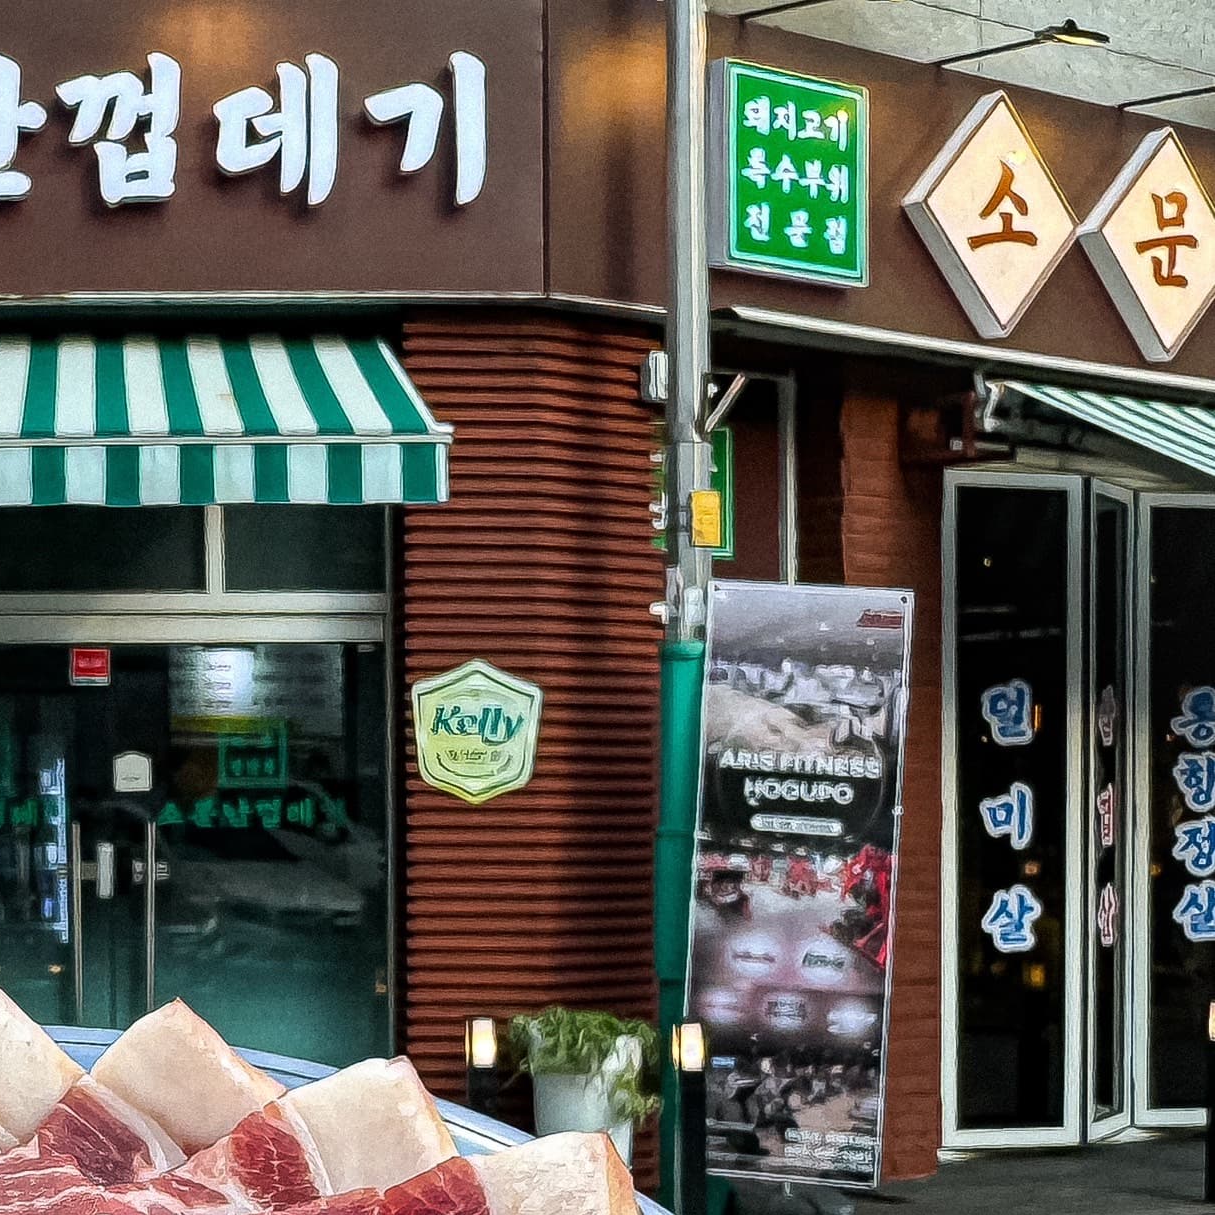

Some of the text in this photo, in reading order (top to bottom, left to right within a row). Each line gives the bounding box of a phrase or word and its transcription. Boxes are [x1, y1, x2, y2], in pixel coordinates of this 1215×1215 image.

[742, 95, 850, 152] 돼지고기
[740, 147, 850, 204] 특수부위
[430, 703, 525, 746] Kelly
